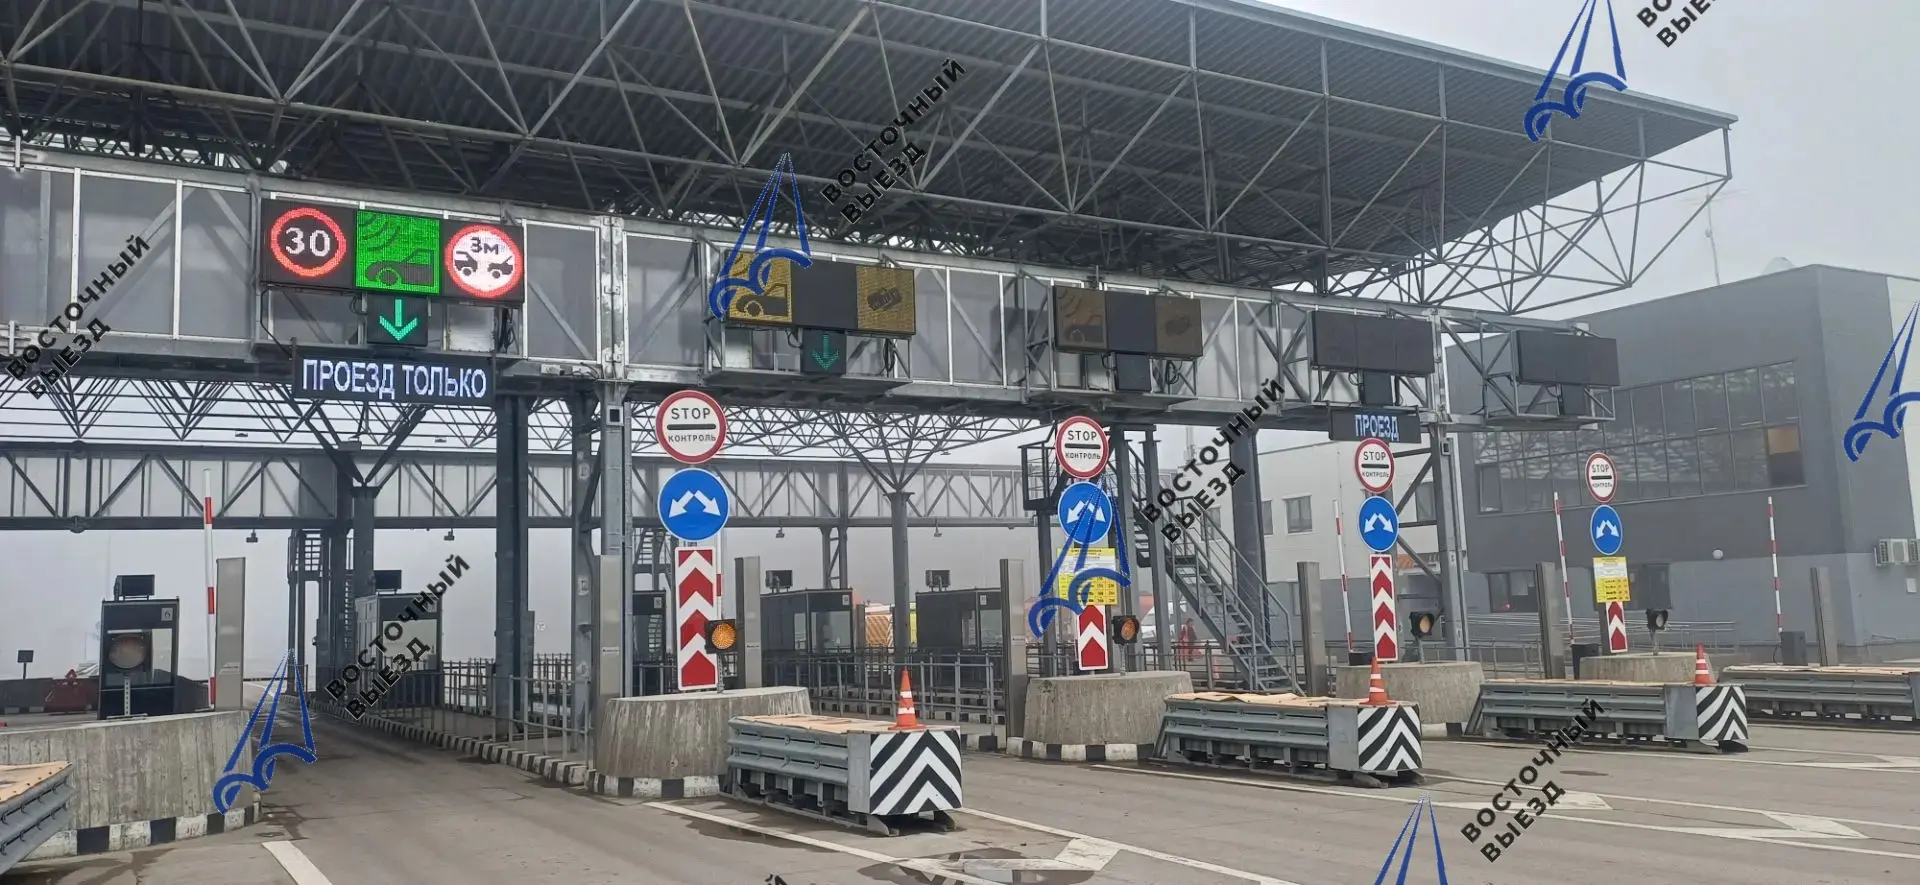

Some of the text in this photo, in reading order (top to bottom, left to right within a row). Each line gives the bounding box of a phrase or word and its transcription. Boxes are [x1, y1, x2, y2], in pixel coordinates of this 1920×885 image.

[285, 227, 331, 257] 30
[302, 358, 487, 400] ПРОЕЗД ТОЛЬКО
[671, 407, 711, 420] STOP
[1354, 414, 1400, 442] ПРОЕЗД
[668, 434, 717, 443] КОНТРОЛЬ
[1067, 430, 1097, 441] STOP
[1065, 452, 1101, 460] КОНТРОЛЬ
[1363, 451, 1387, 461] STOP
[1591, 464, 1610, 473] STOP
